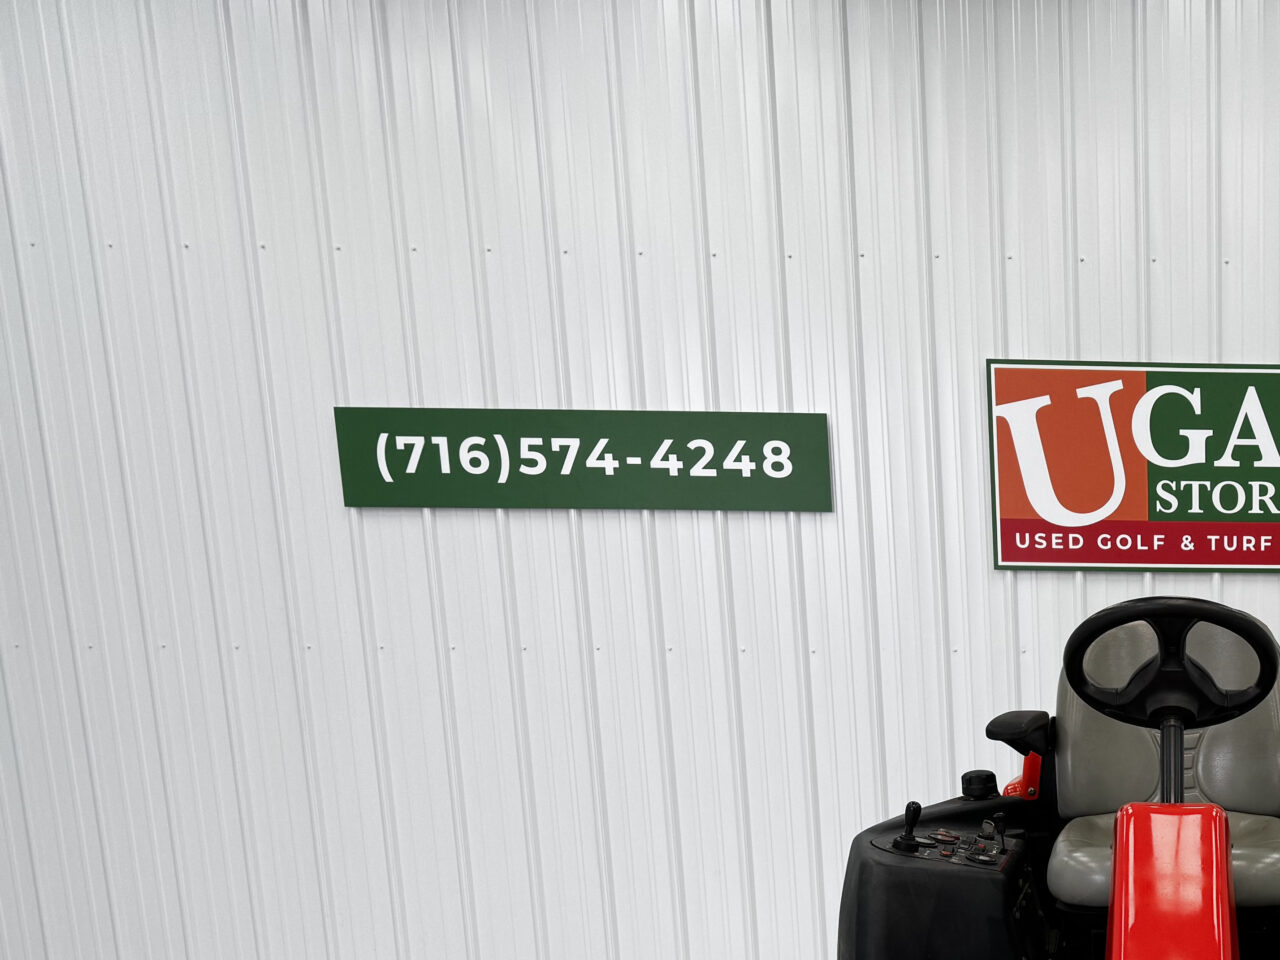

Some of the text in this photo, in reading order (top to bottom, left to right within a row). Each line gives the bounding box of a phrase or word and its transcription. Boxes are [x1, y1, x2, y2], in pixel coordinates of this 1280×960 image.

[376, 432, 793, 483] (716)574-4248
[1015, 532, 1084, 550] USED
[1097, 533, 1165, 550] GOLF
[1180, 534, 1195, 551] &
[1206, 535, 1273, 552] TURF
